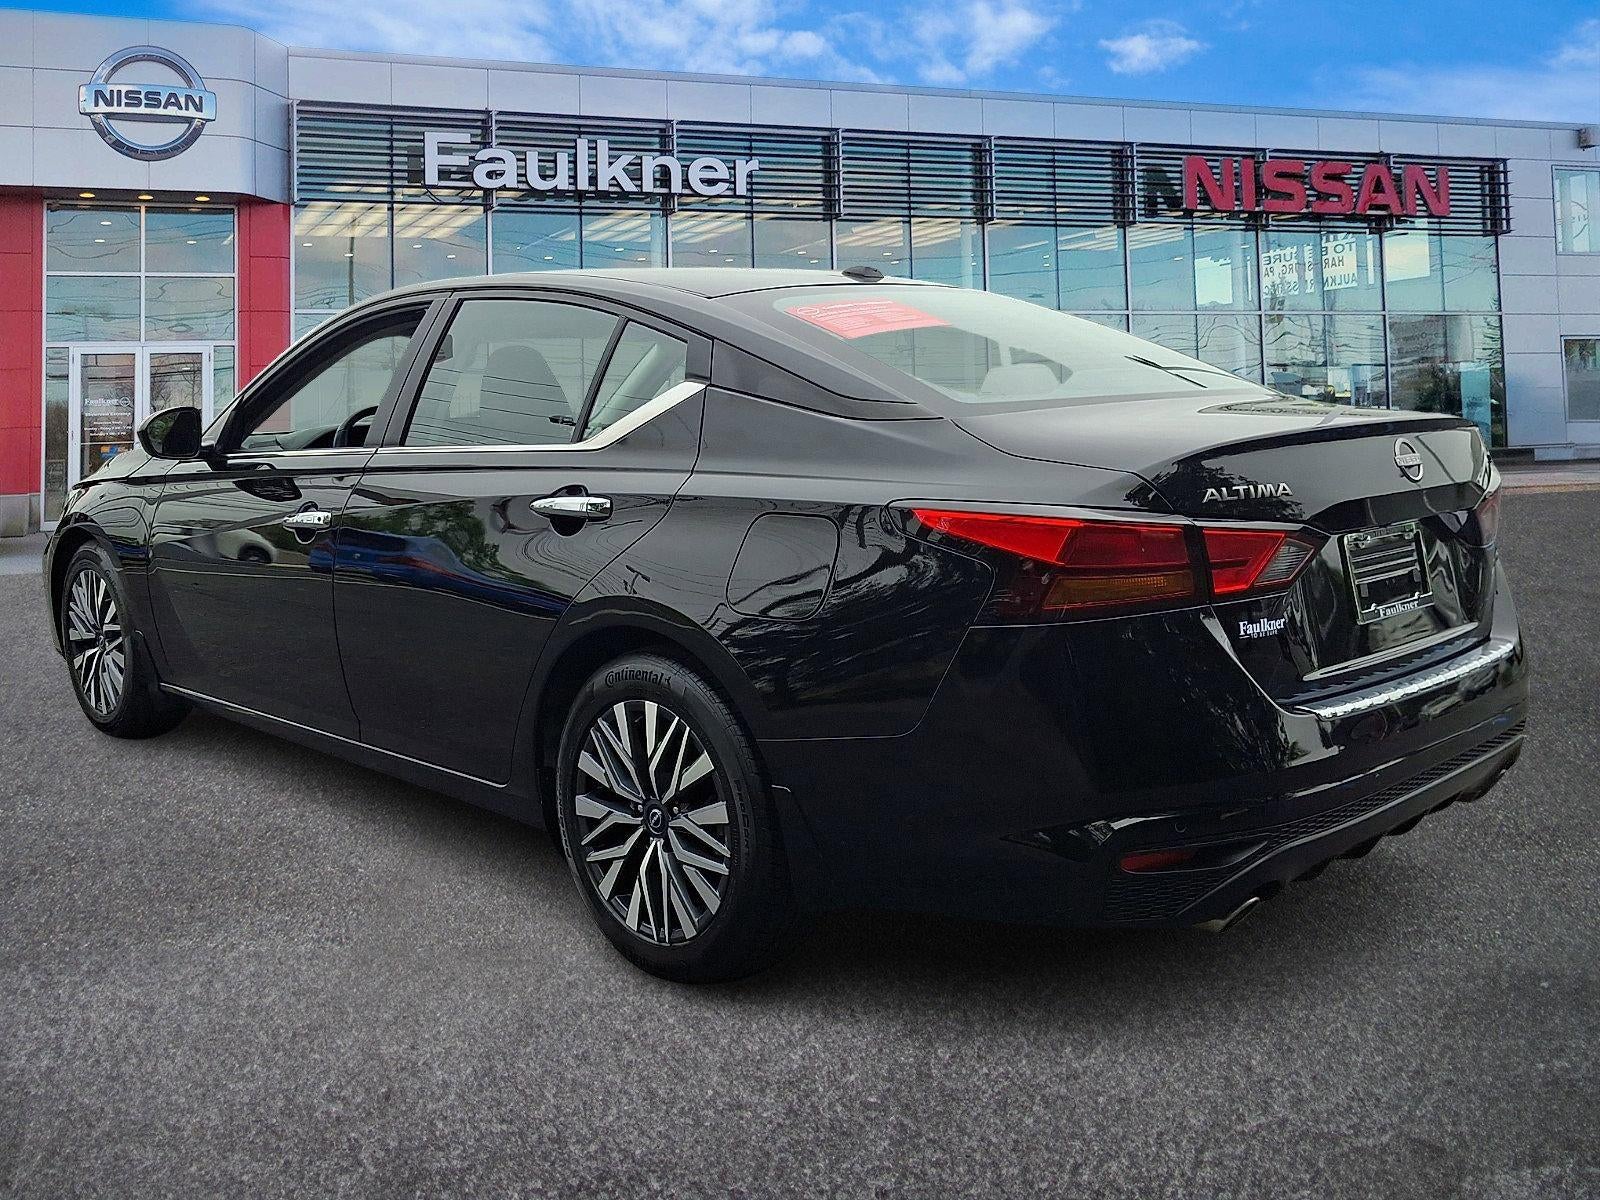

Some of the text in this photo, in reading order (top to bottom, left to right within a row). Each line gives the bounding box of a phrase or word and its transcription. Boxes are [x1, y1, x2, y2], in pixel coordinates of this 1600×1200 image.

[94, 89, 204, 113] NISSAN
[423, 131, 760, 197] Faulkner
[1182, 155, 1450, 217] NISSAN
[1203, 482, 1293, 503] ALTIMA
[1379, 600, 1419, 618] Faulkner
[1238, 618, 1286, 636] Faulkner
[604, 665, 664, 687] Continental
